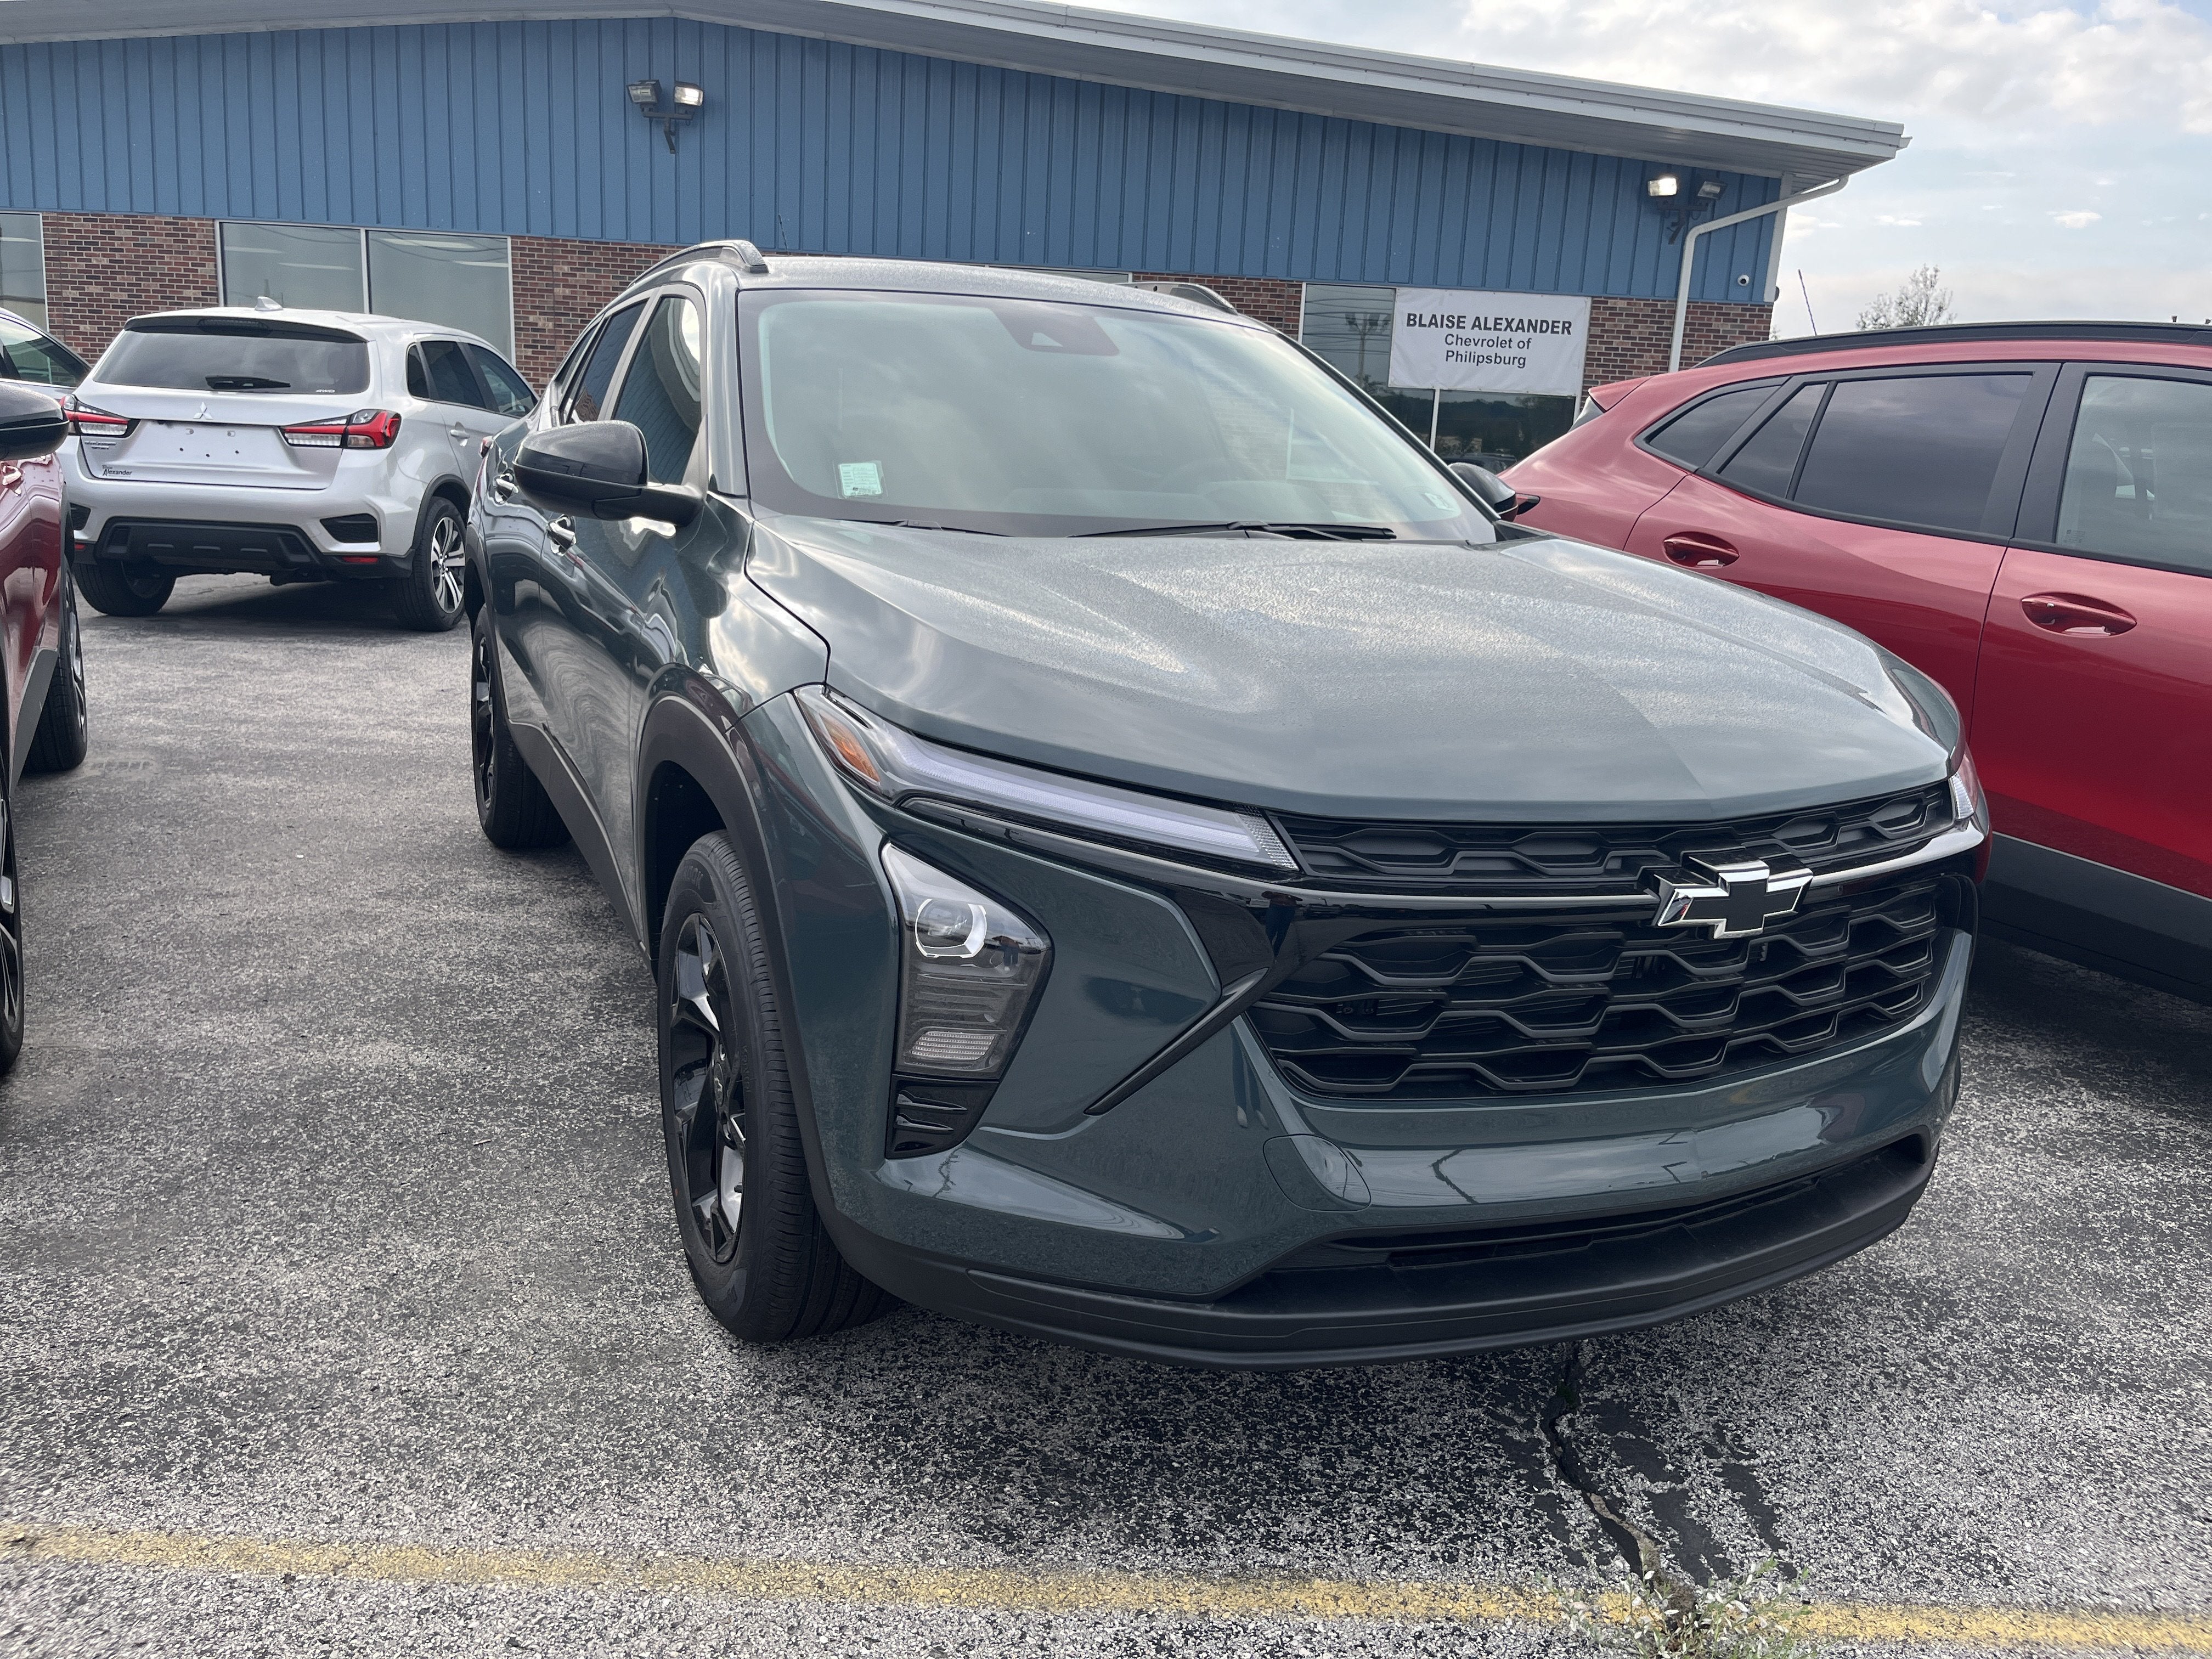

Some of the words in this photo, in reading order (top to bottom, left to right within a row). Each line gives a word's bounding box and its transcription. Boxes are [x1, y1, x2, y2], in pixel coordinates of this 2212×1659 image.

[1407, 313, 1466, 329] BLAISE
[1471, 317, 1572, 335] ALEXANDER
[1444, 334, 1513, 349] Chevrolet
[1517, 338, 1532, 349] of
[1446, 350, 1526, 369] Philipsburg
